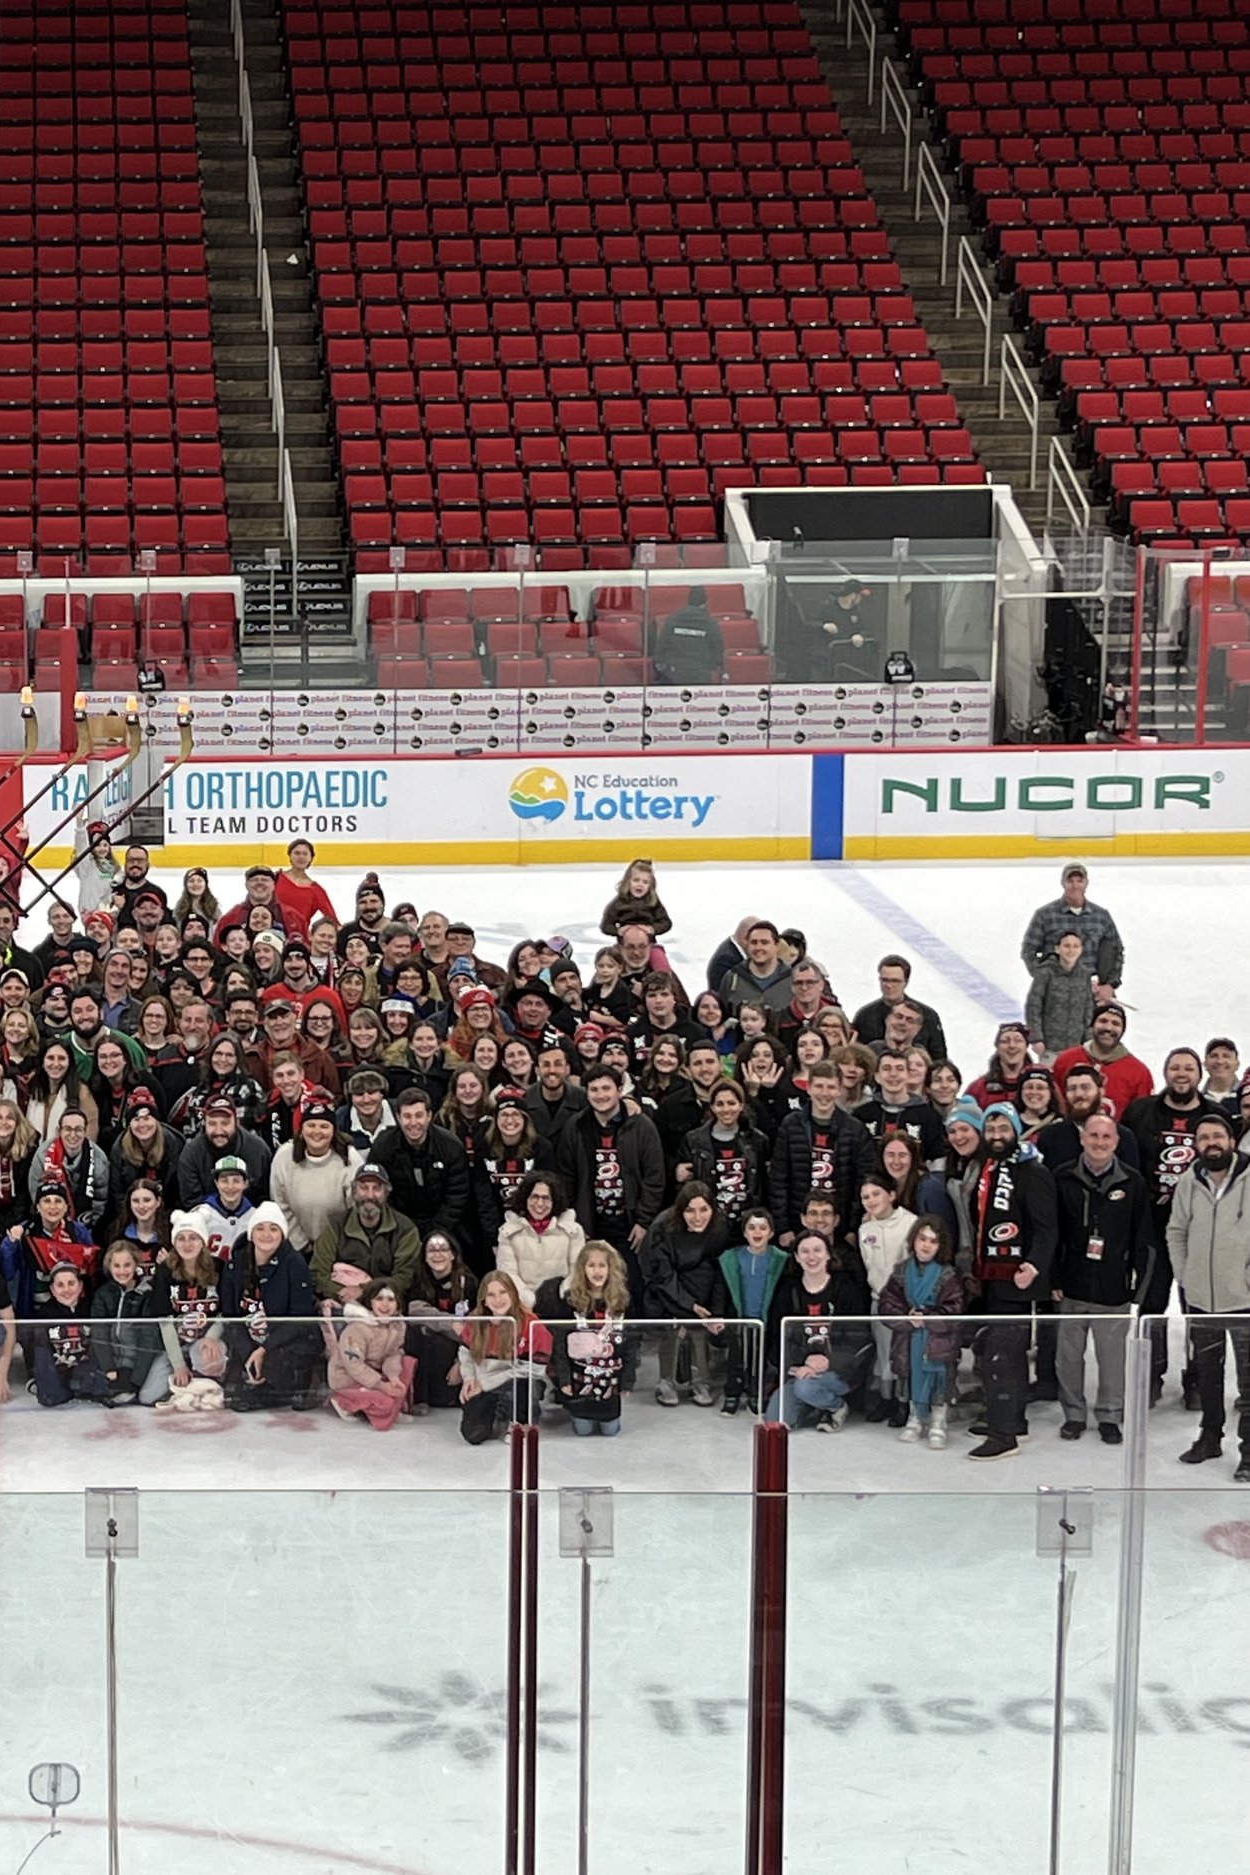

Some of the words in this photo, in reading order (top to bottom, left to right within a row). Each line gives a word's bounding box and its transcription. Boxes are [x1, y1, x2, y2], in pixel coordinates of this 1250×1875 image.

[674, 628, 706, 638] SECURITY
[187, 770, 387, 809] ORTHOPAEDIC
[574, 774, 599, 789] NC
[603, 774, 678, 789] Education
[882, 776, 1210, 813] NUCOR
[575, 793, 712, 828] Lottery
[187, 816, 246, 834] TEAM
[257, 815, 358, 832] DOCTORS
